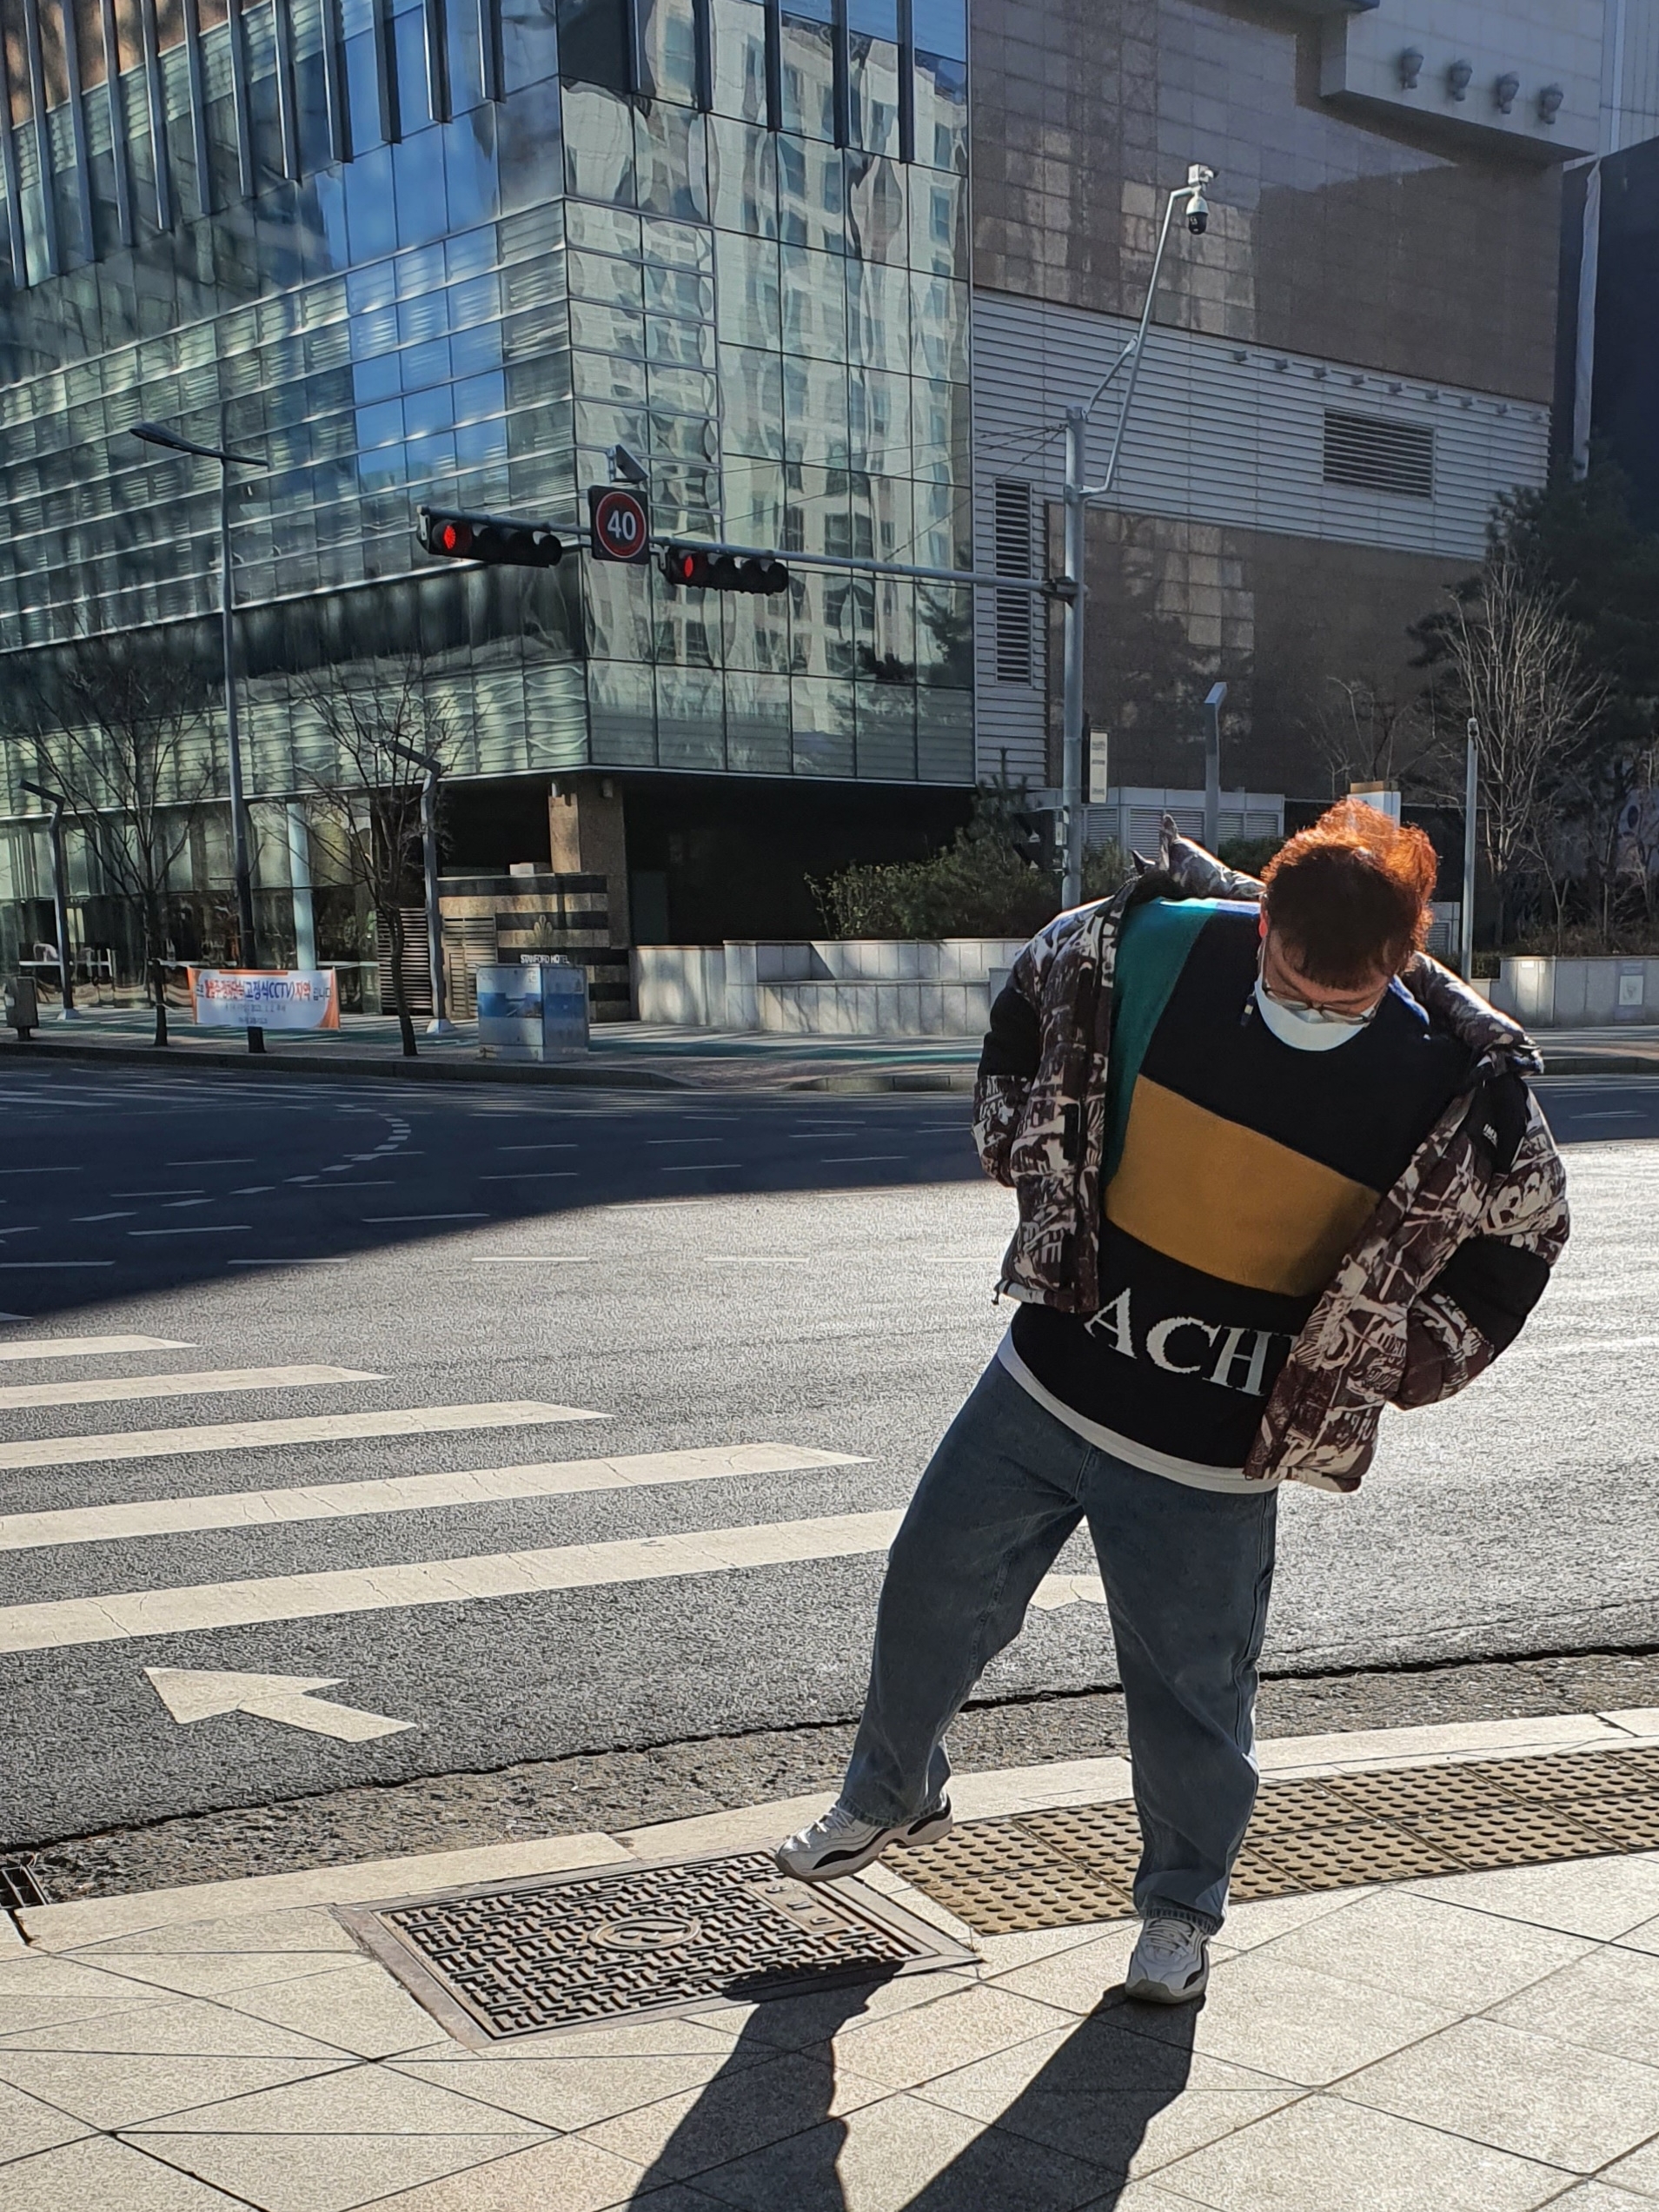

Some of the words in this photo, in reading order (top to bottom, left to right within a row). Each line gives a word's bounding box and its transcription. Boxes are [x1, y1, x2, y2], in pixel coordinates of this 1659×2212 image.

[607, 509, 636, 540] 40
[521, 954, 549, 964] STANFORD
[550, 954, 569, 964] HOTEL
[1084, 1288, 1299, 1396] ACH
